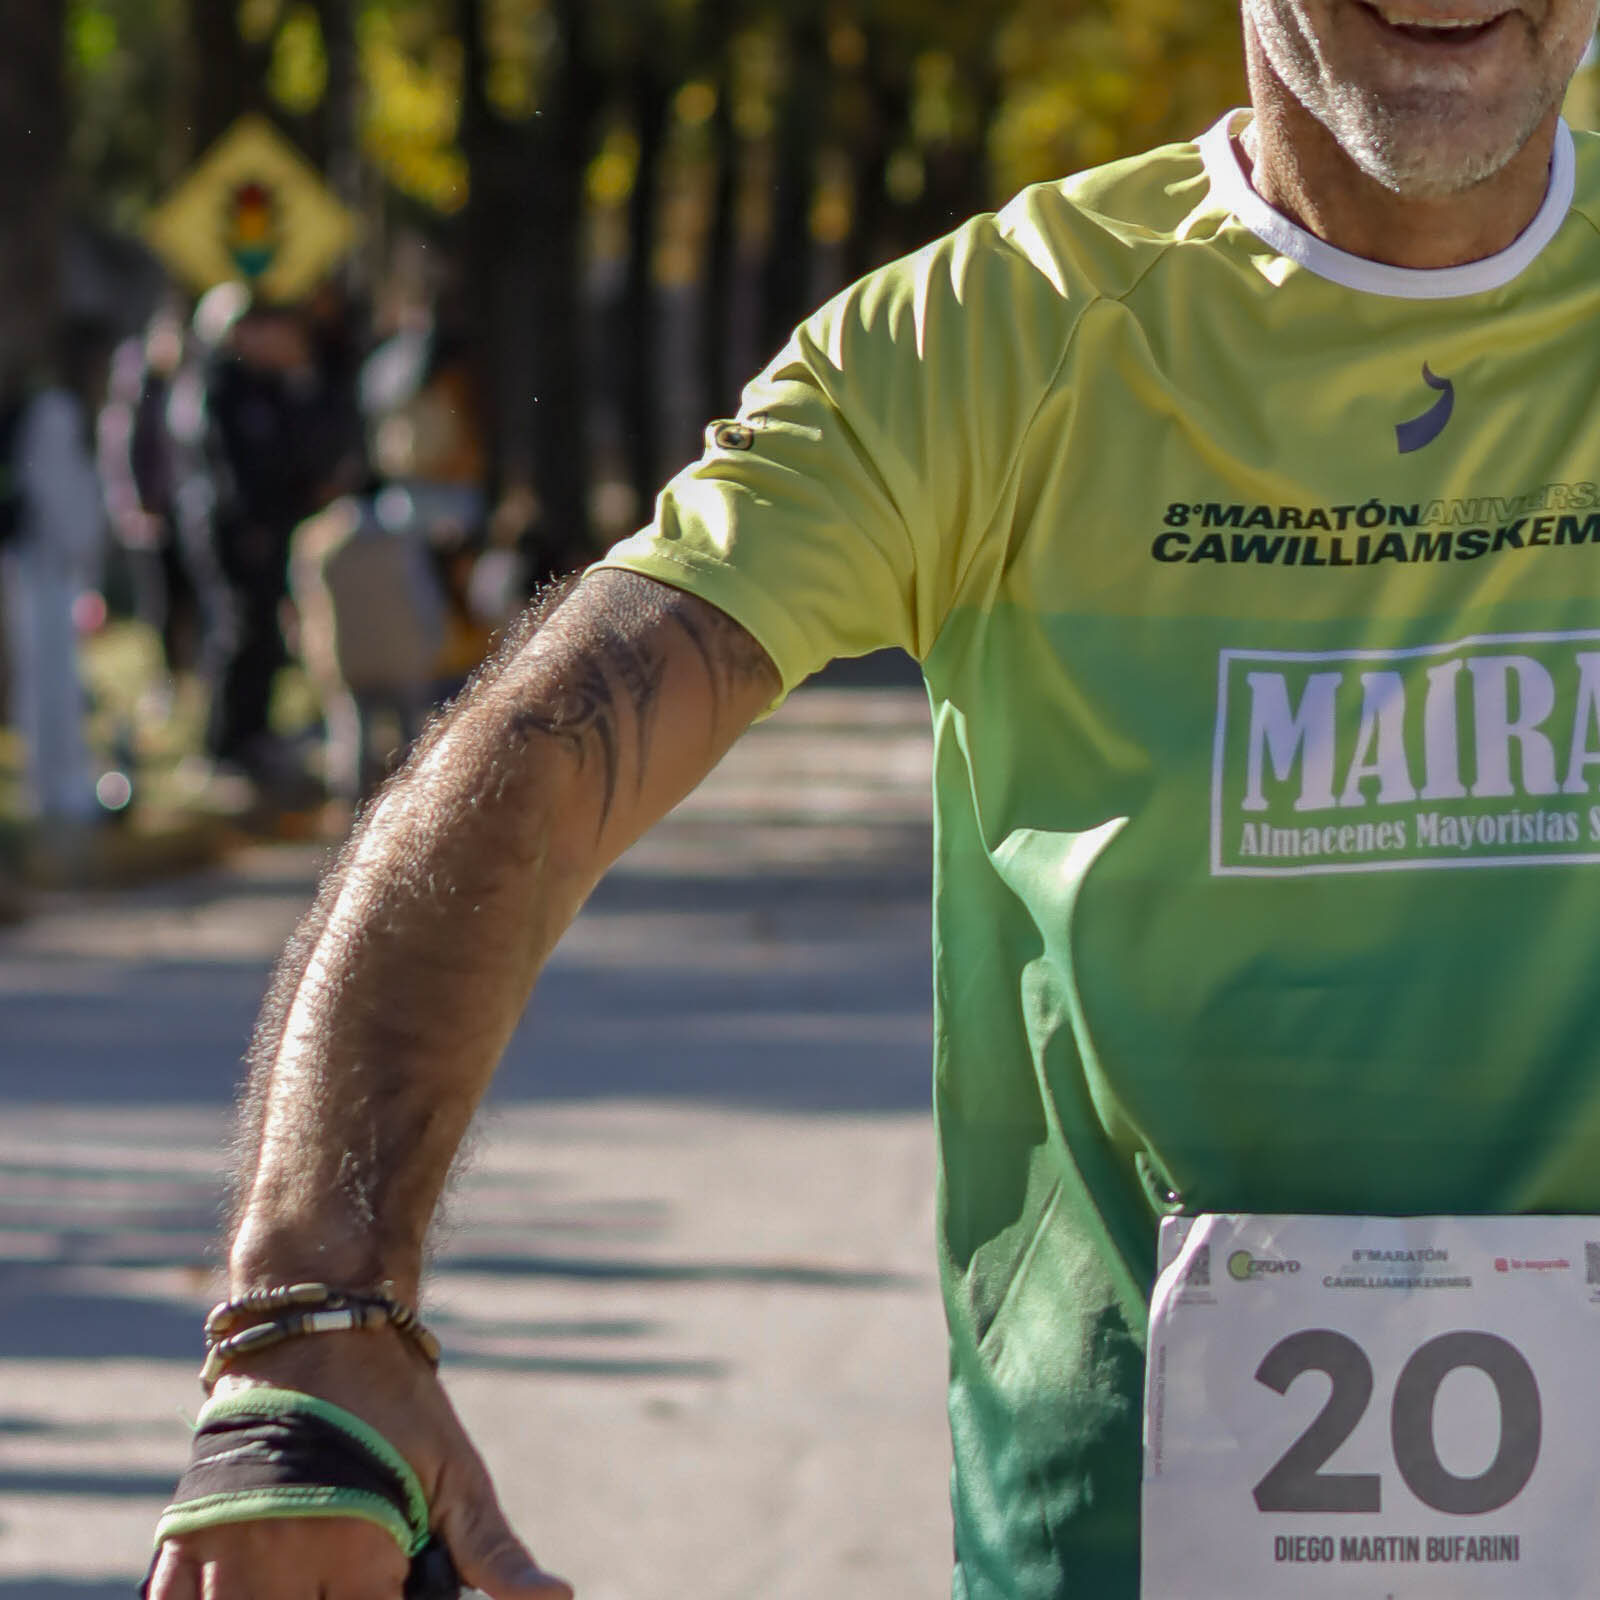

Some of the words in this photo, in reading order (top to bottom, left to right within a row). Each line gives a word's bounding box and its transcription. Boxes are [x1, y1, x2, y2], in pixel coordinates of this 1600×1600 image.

[1238, 819, 1406, 857] Almacenes
[1415, 808, 1579, 850] Mayoristas
[1252, 1329, 1543, 1515] 20
[1274, 1535, 1334, 1563] DIEGO
[1340, 1535, 1420, 1563] MARTIN
[1426, 1535, 1520, 1563] BUFARINI
